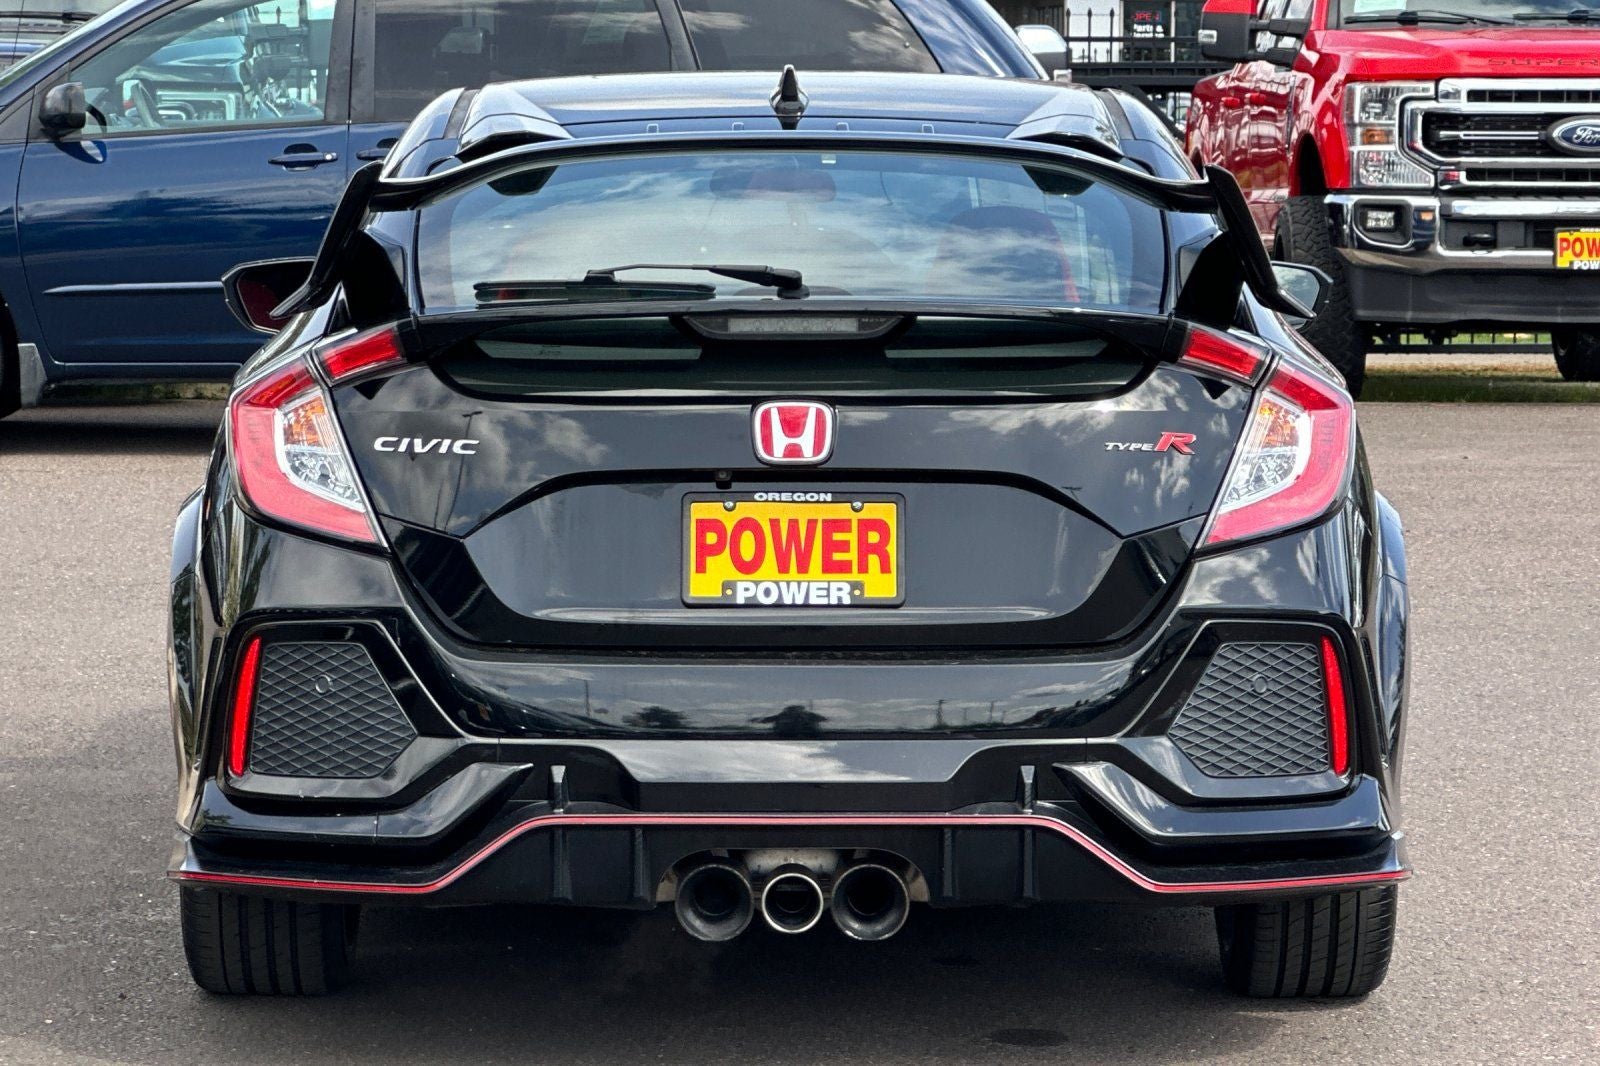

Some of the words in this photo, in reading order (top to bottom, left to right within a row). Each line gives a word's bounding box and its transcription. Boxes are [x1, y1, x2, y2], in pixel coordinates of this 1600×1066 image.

[1573, 126, 1600, 144] For
[373, 436, 480, 455] CIVIC
[1105, 442, 1155, 451] TYPE
[1154, 431, 1197, 455] R
[753, 492, 833, 502] OREGON
[695, 516, 892, 575] POWER
[736, 581, 851, 605] POWER
